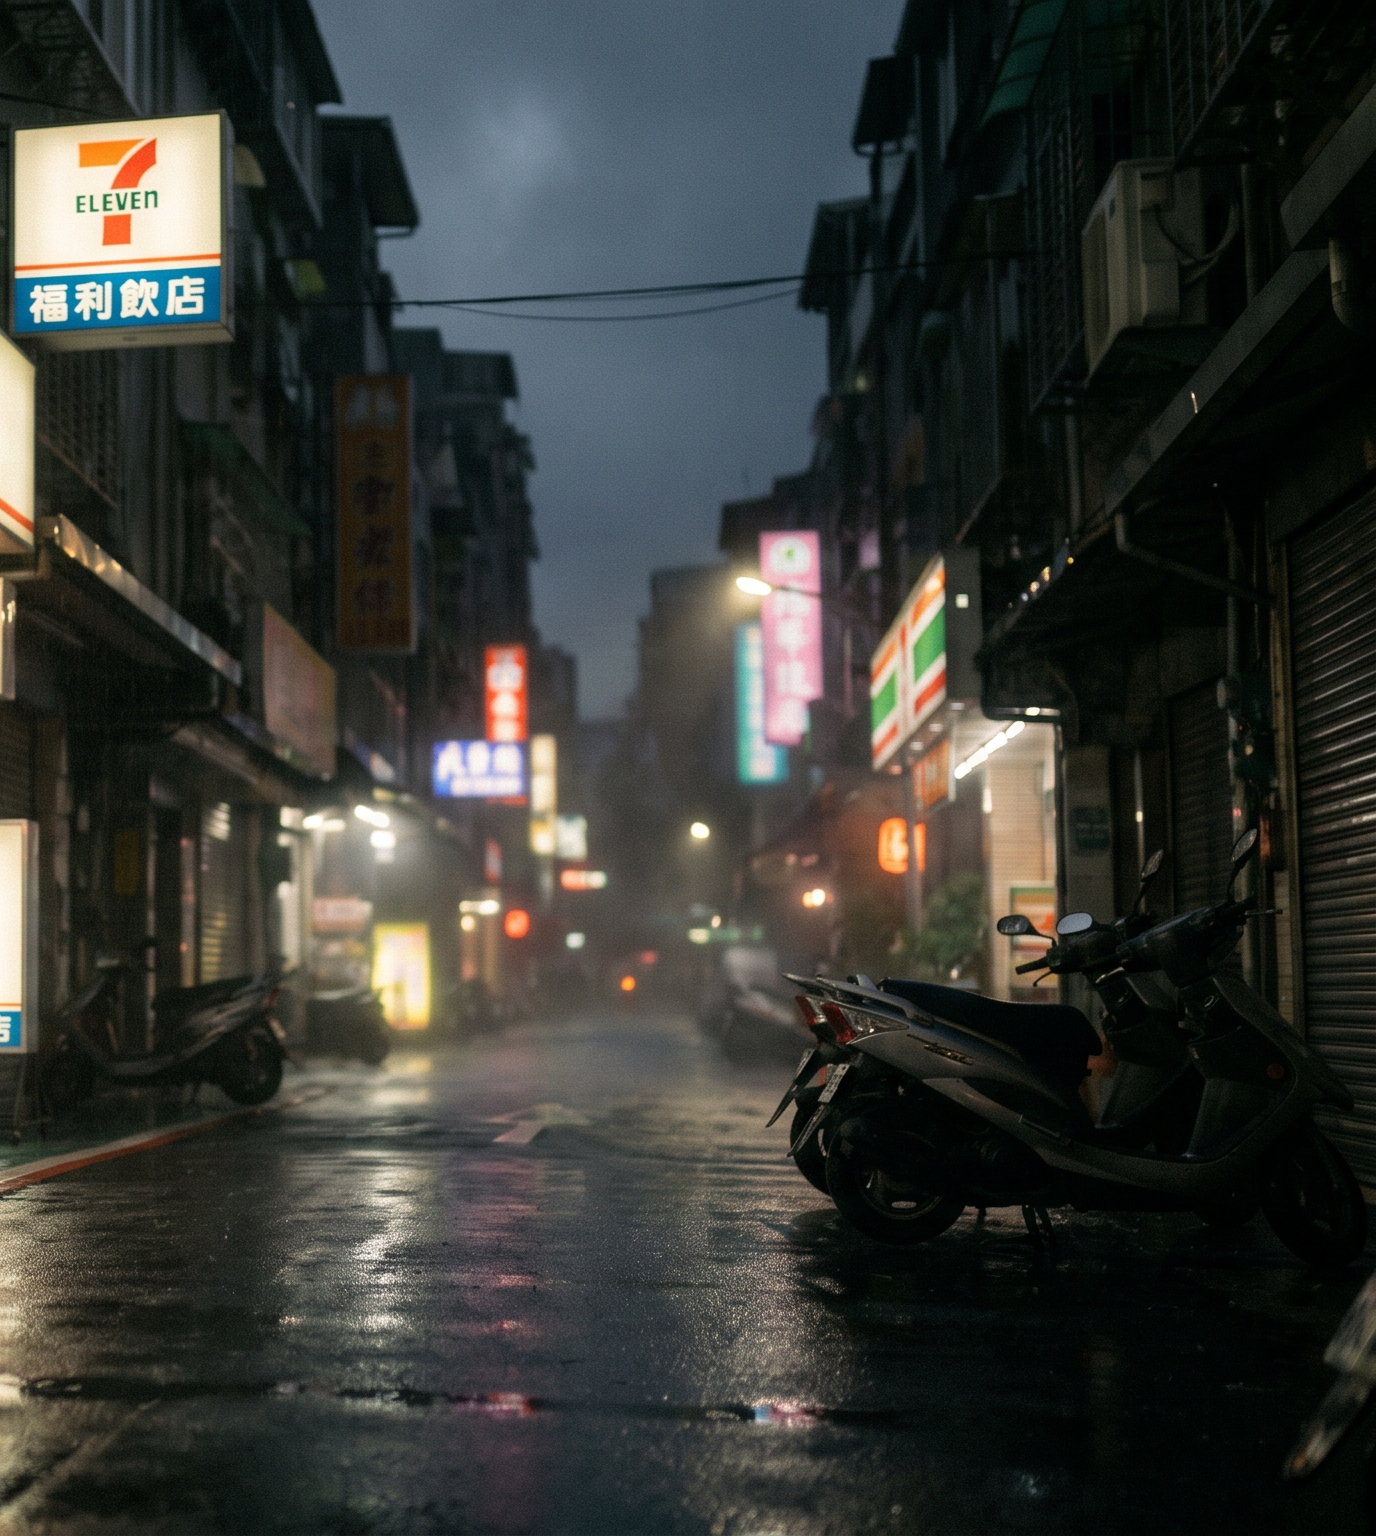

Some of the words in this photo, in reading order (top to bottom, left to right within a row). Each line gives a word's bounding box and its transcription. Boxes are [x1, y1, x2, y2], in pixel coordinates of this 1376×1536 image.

[78, 137, 158, 246] 7
[29, 275, 206, 324] 福利飲店
